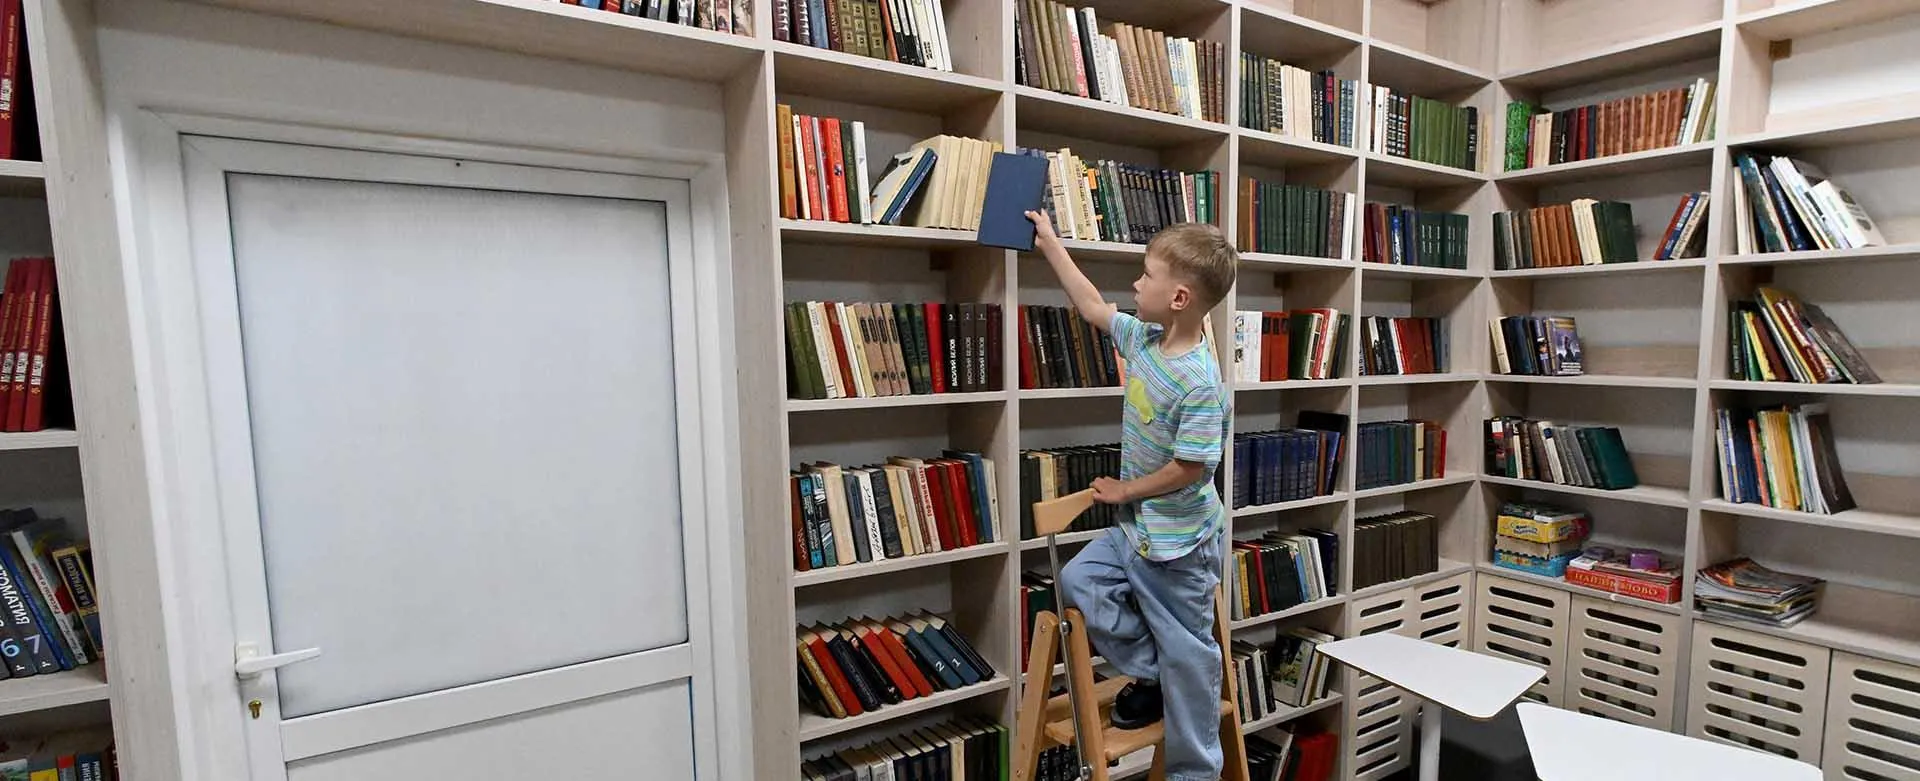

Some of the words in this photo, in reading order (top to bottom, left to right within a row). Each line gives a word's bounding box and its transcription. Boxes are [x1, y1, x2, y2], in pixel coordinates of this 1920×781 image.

[949, 338, 957, 358] БЕЛОВ
[950, 359, 958, 387] ВАСИЛИЙ
[0, 563, 30, 625] ТОМАТИЯ
[0, 638, 20, 657] 6
[23, 634, 40, 654] 7
[935, 660, 945, 672] 2
[951, 657, 961, 668] 1
